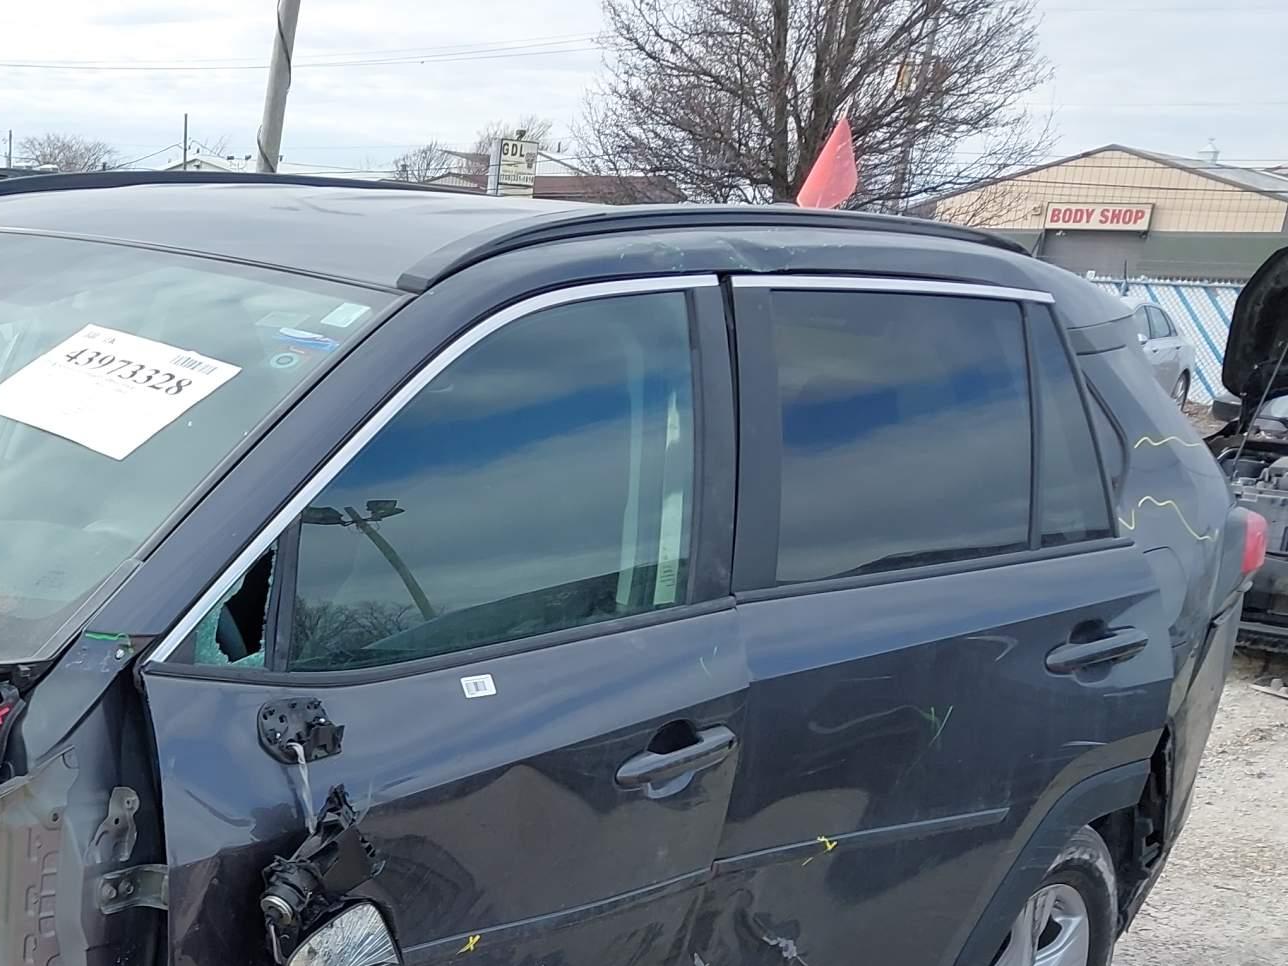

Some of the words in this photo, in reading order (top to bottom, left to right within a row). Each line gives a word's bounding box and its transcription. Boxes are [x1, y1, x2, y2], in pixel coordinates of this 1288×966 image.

[502, 142, 525, 158] GDL
[1049, 207, 1095, 224] BODY
[1099, 209, 1146, 225] SHOP
[65, 347, 193, 396] 43973328
